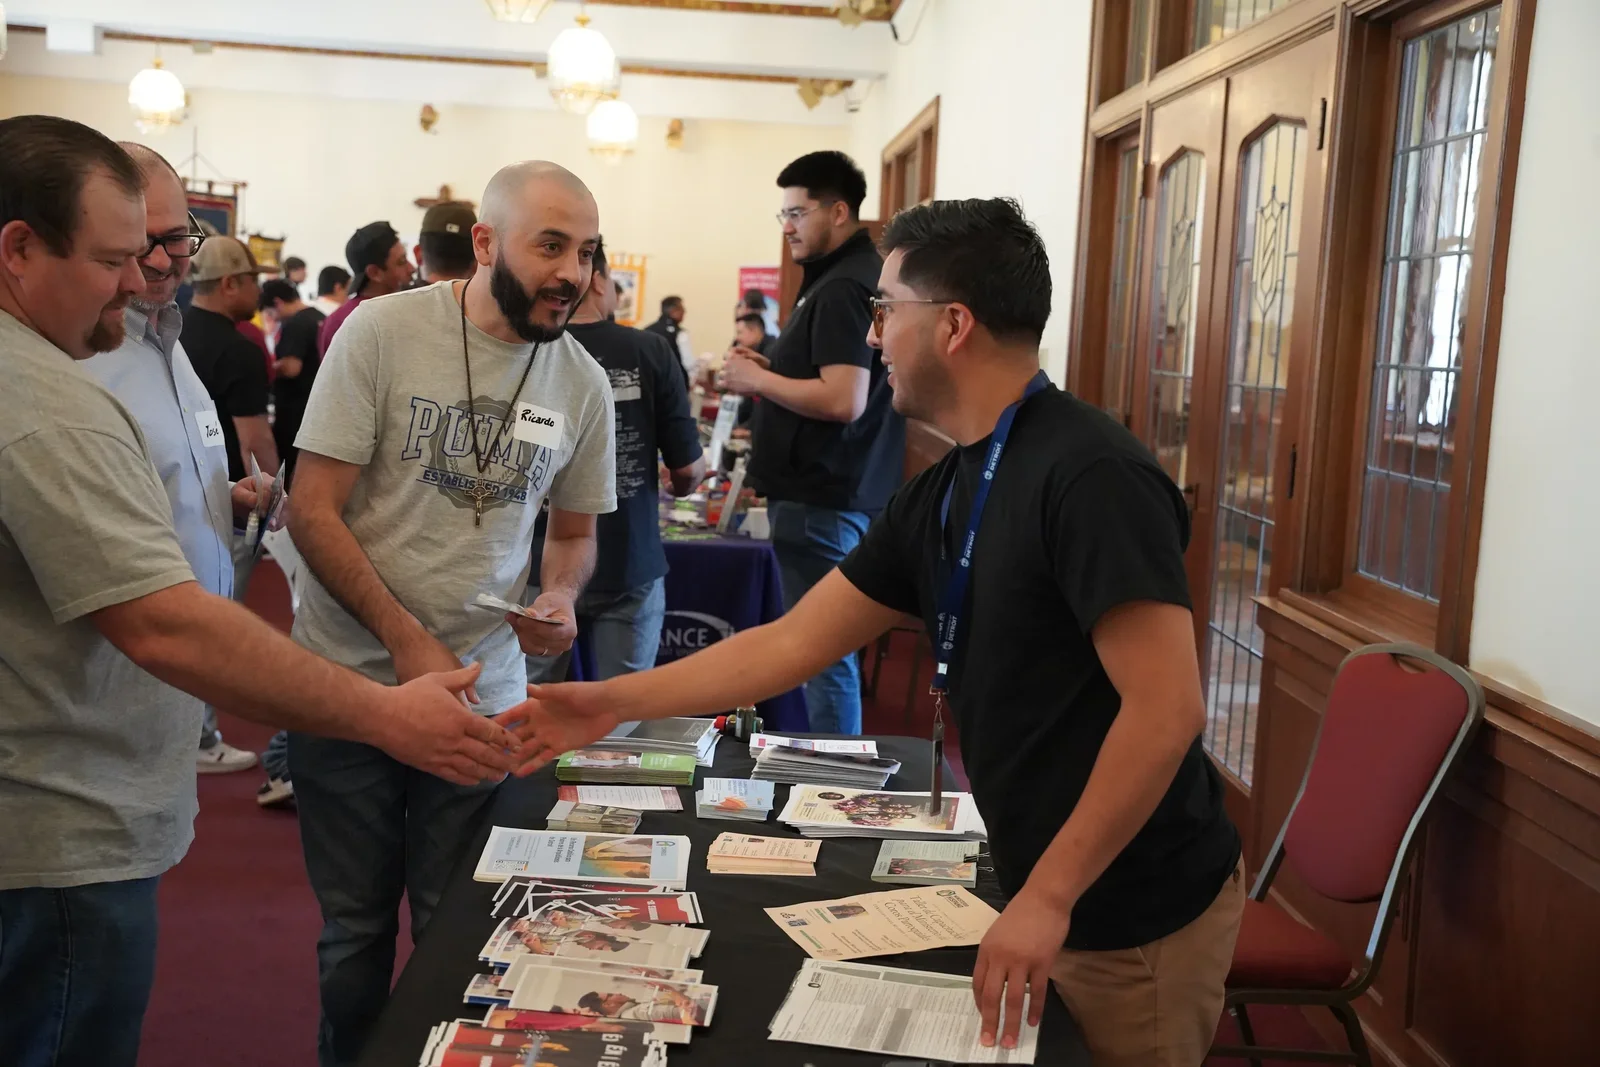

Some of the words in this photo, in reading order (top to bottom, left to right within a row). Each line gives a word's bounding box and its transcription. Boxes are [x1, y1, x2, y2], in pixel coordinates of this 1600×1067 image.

[520, 409, 555, 427] Ricardo
[402, 396, 552, 492] PUMA
[990, 443, 1002, 471] DETROIT
[422, 469, 500, 495] ESTABLISED
[503, 487, 527, 501] 1948
[965, 531, 976, 558] DETROIT
[948, 615, 958, 642] DETROIT
